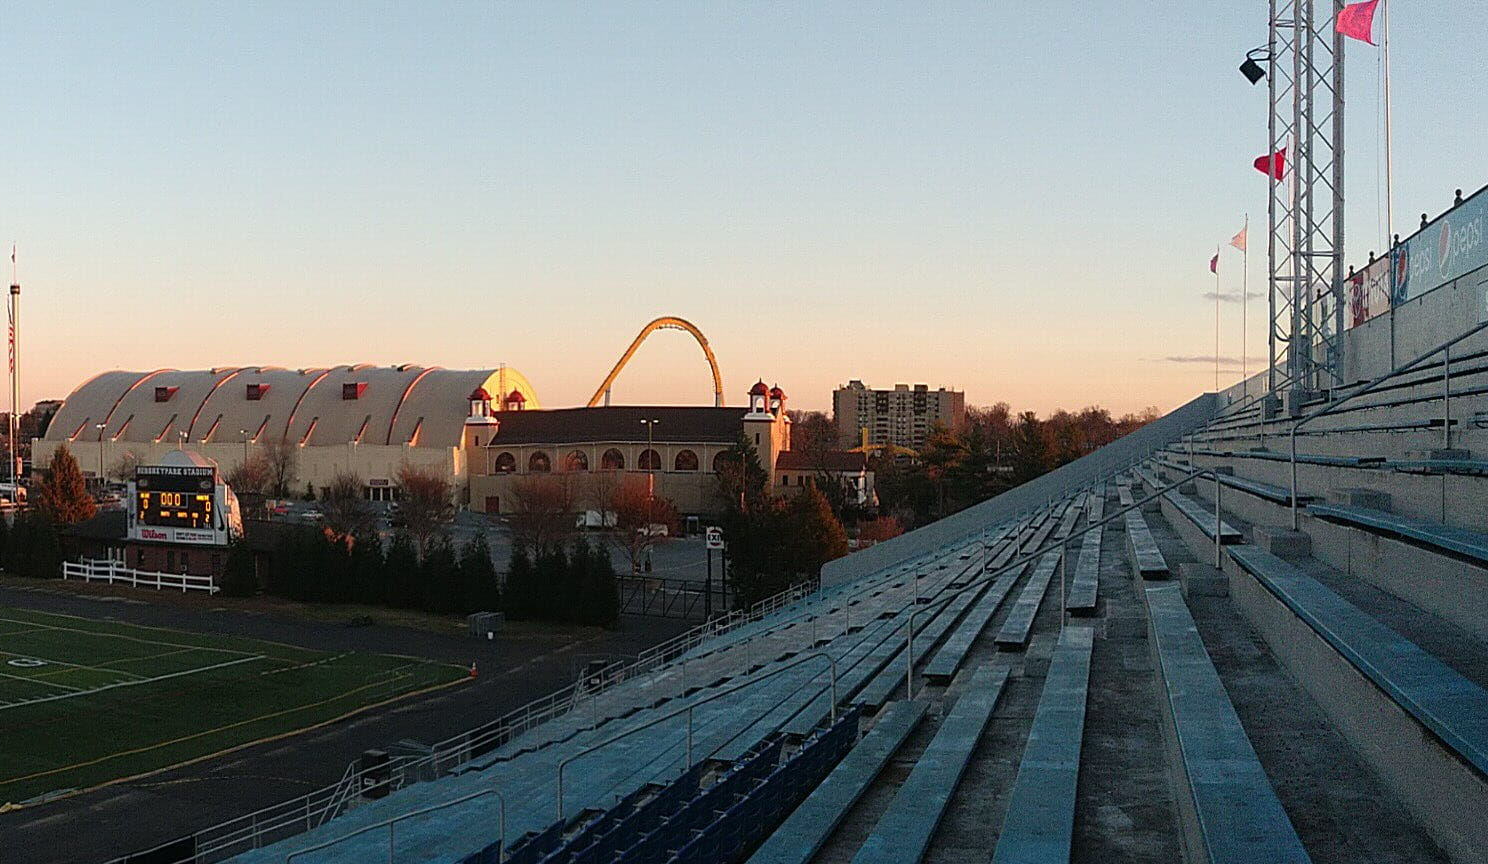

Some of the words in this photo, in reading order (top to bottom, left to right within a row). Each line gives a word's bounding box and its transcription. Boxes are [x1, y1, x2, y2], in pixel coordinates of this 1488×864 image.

[1453, 208, 1484, 265] pepsi
[137, 467, 182, 476] HERSHEYPARK
[183, 468, 213, 476] STADIUM
[143, 499, 148, 510] 0
[205, 501, 211, 512] 0
[142, 529, 167, 540] Wilson
